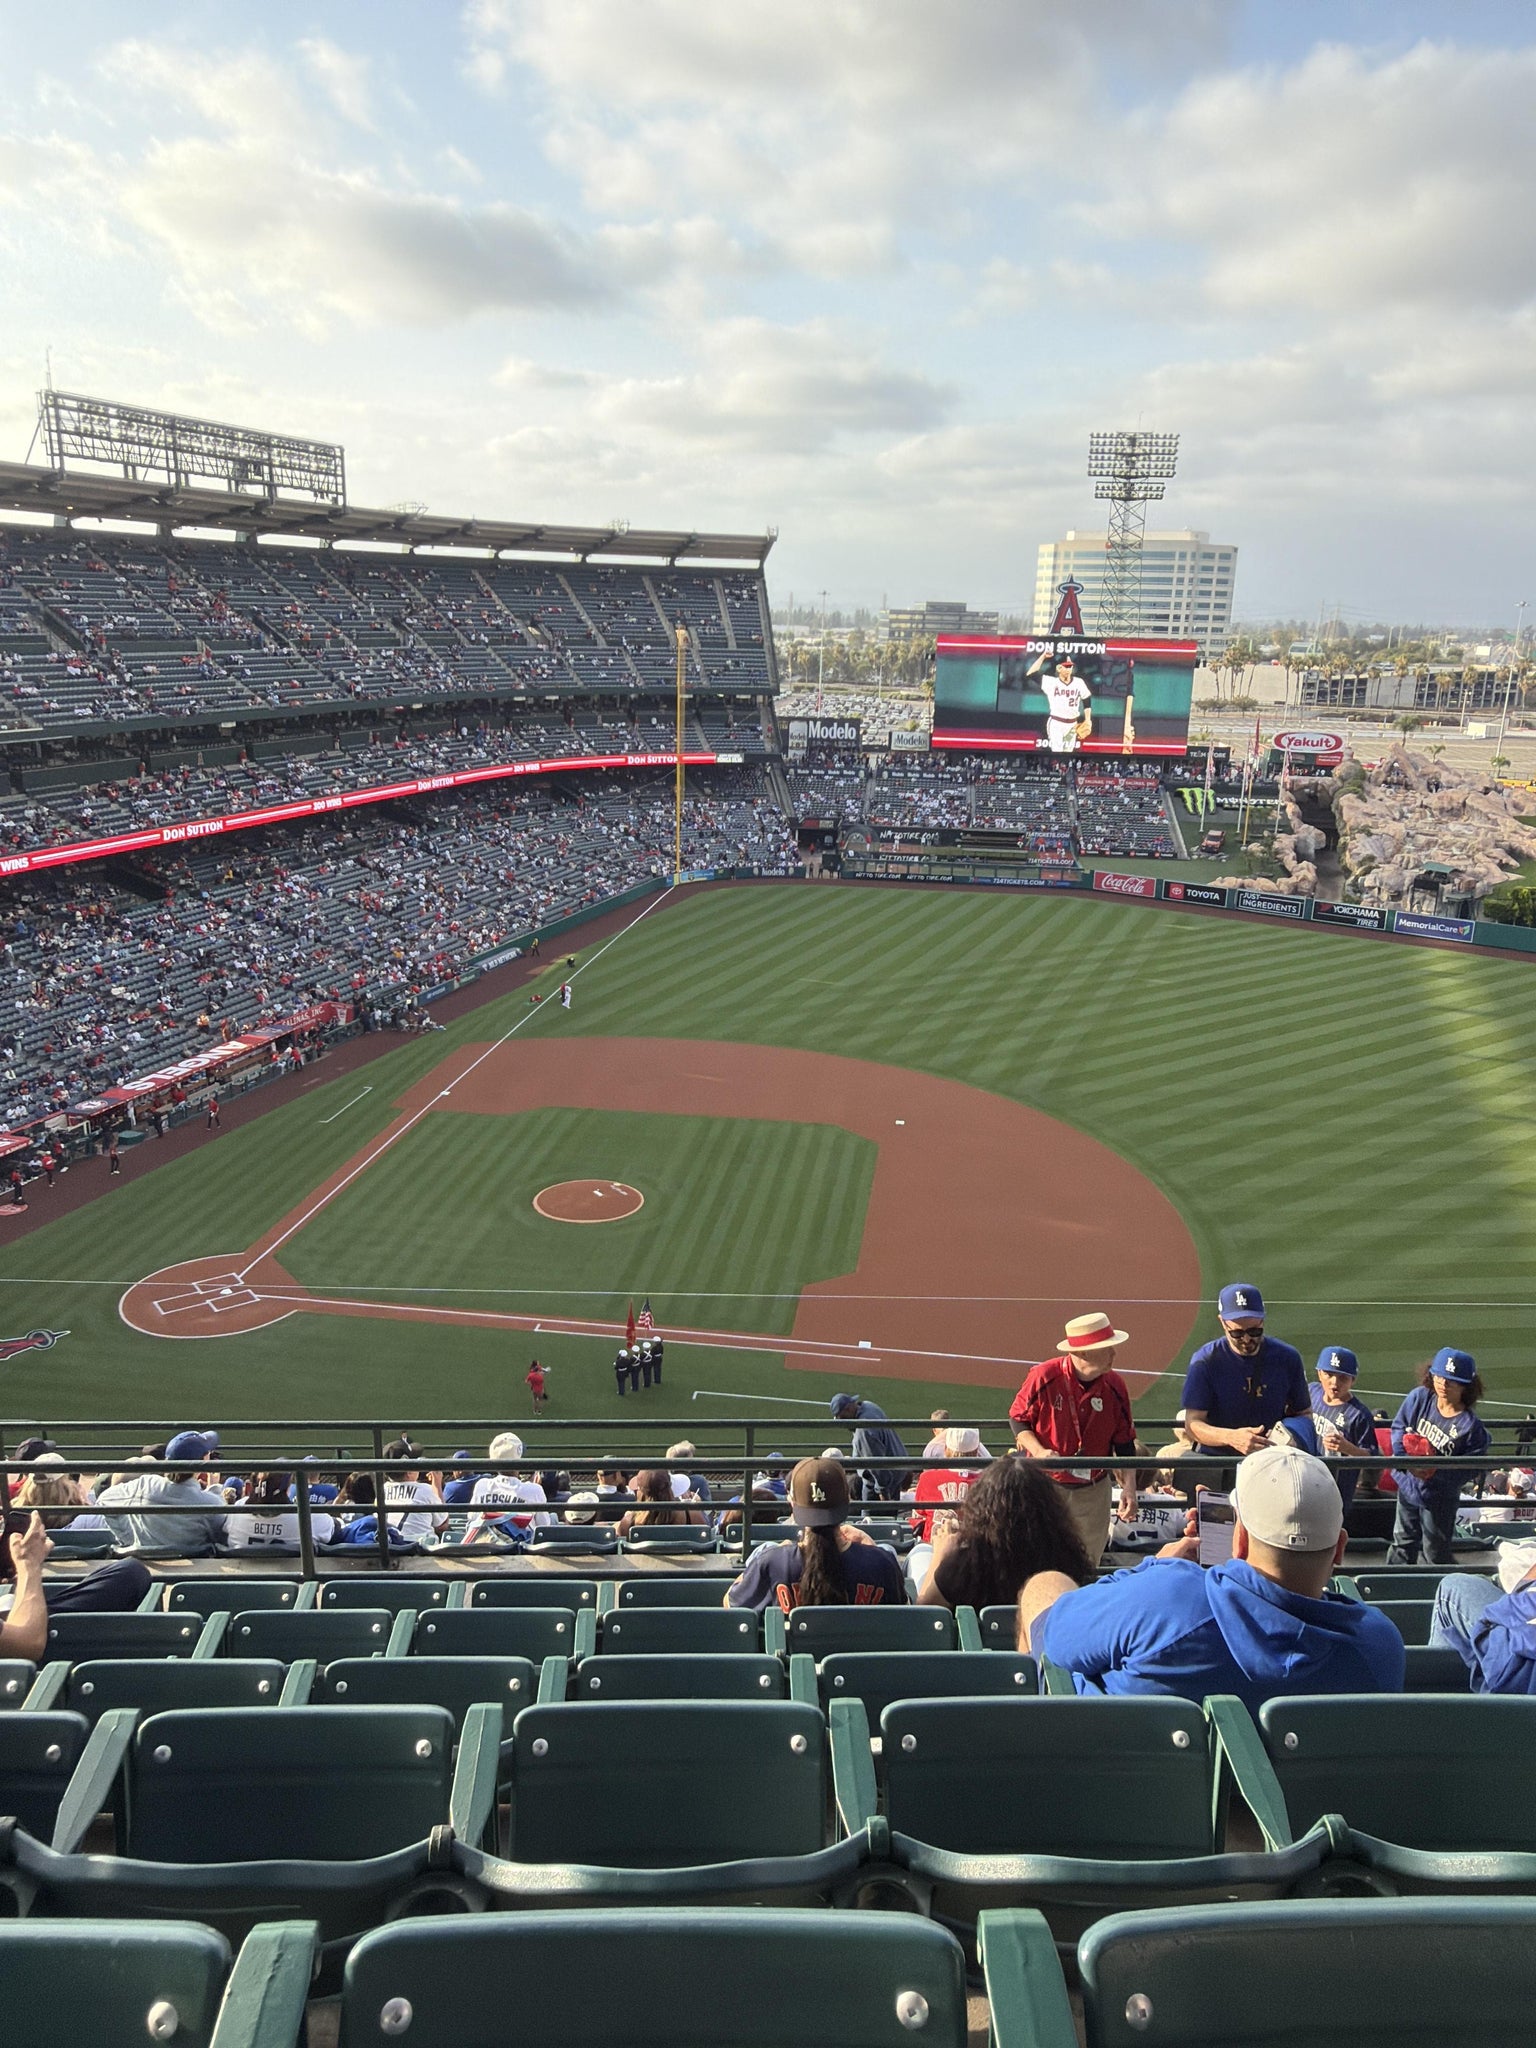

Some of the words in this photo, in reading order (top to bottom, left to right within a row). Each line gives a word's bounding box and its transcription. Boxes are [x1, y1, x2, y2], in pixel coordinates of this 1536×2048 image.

[1026, 641, 1055, 653] DON
[1056, 642, 1106, 655] SUTTON
[808, 720, 857, 740] Modelo
[894, 734, 927, 746] Modelo
[1286, 736, 1333, 748] Yakult
[628, 755, 646, 765] DON
[417, 781, 431, 791] DON
[432, 776, 454, 789] SUTTON
[326, 797, 342, 808] WINS
[163, 827, 185, 841] DON
[186, 820, 223, 837] SUTTON
[0, 857, 29, 872] WINS
[1186, 889, 1220, 900] TOYOTA
[1242, 899, 1297, 913] INGREDIENTS
[1332, 906, 1381, 918] YOKOHAMA
[1356, 918, 1379, 928] TIRES
[1398, 919, 1458, 933] MemorialCare
[122, 1040, 248, 1091] ANGELS
[1235, 1290, 1247, 1306] LA
[1330, 1352, 1341, 1367] LA
[1445, 1357, 1456, 1373] LA
[810, 1482, 827, 1502] LA
[254, 1522, 283, 1535] BETTS
